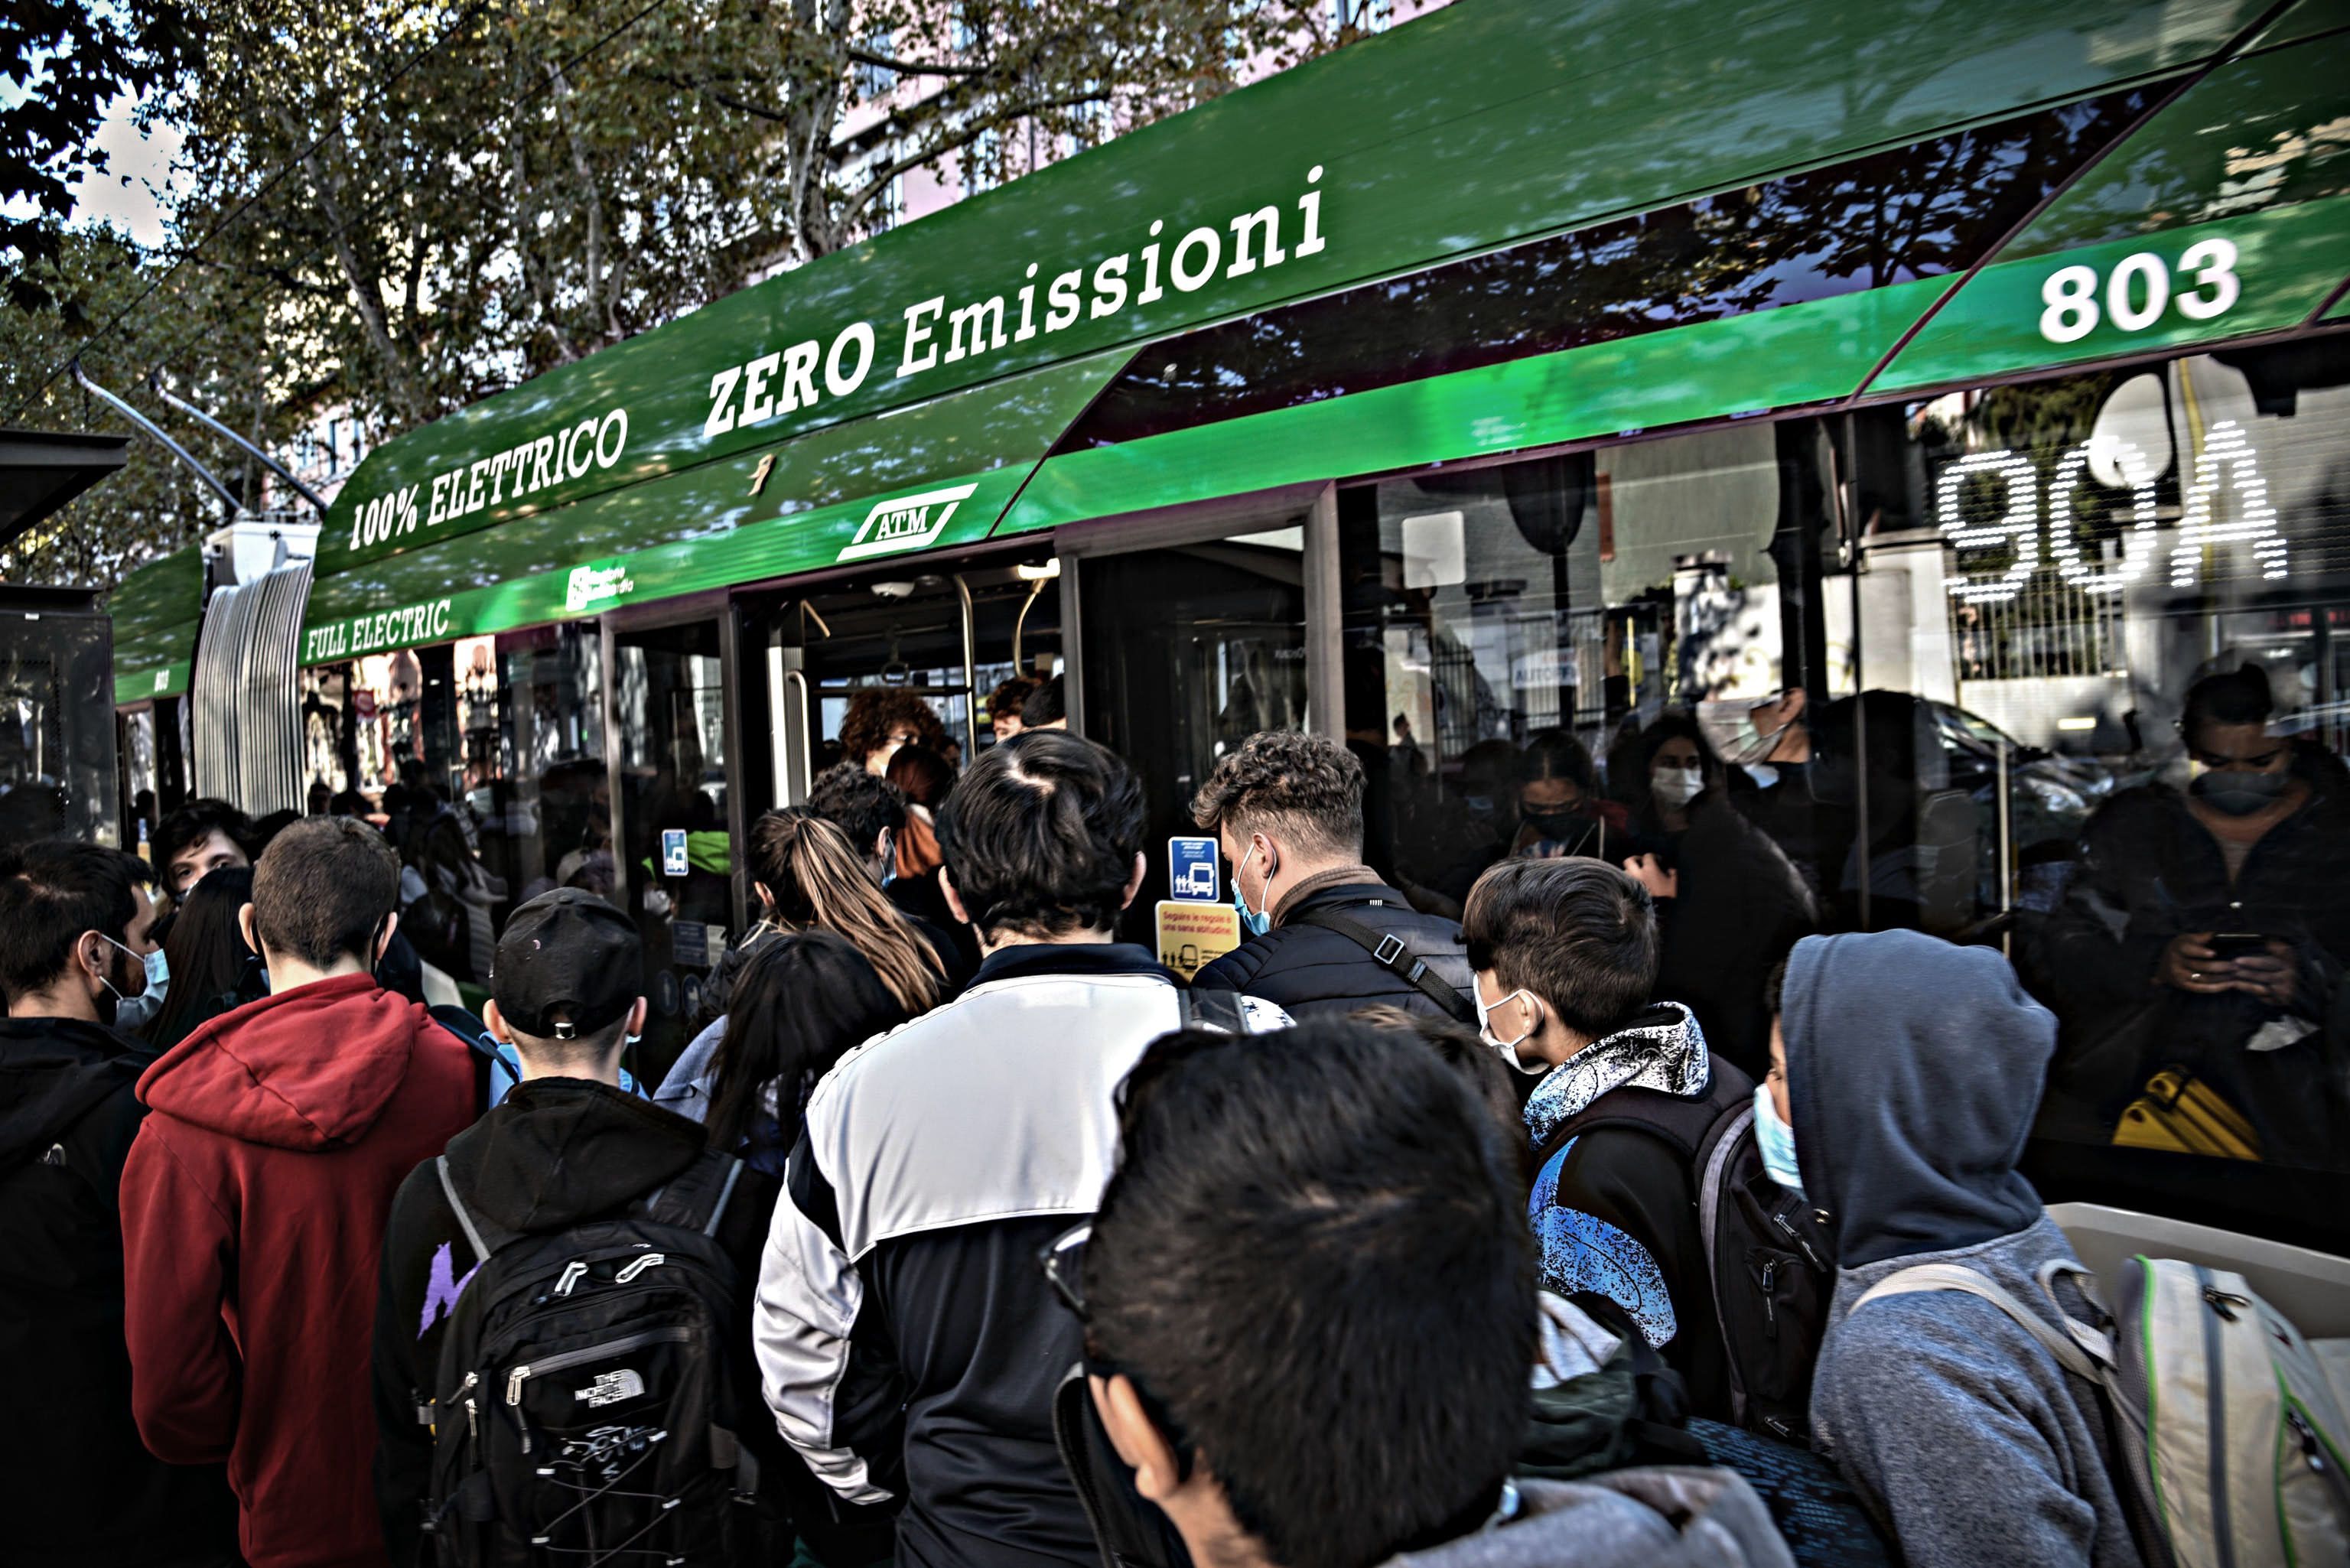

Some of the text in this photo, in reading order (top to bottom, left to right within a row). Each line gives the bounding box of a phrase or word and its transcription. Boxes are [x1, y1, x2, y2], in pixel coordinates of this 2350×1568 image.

[704, 164, 1326, 439] ZERO Emissioni
[2039, 238, 2239, 343] 803
[350, 408, 629, 551] 100% ELETTRICO
[875, 505, 929, 541] ATM
[306, 599, 451, 661] FULL ELECTRIC
[594, 1369, 622, 1386] THE
